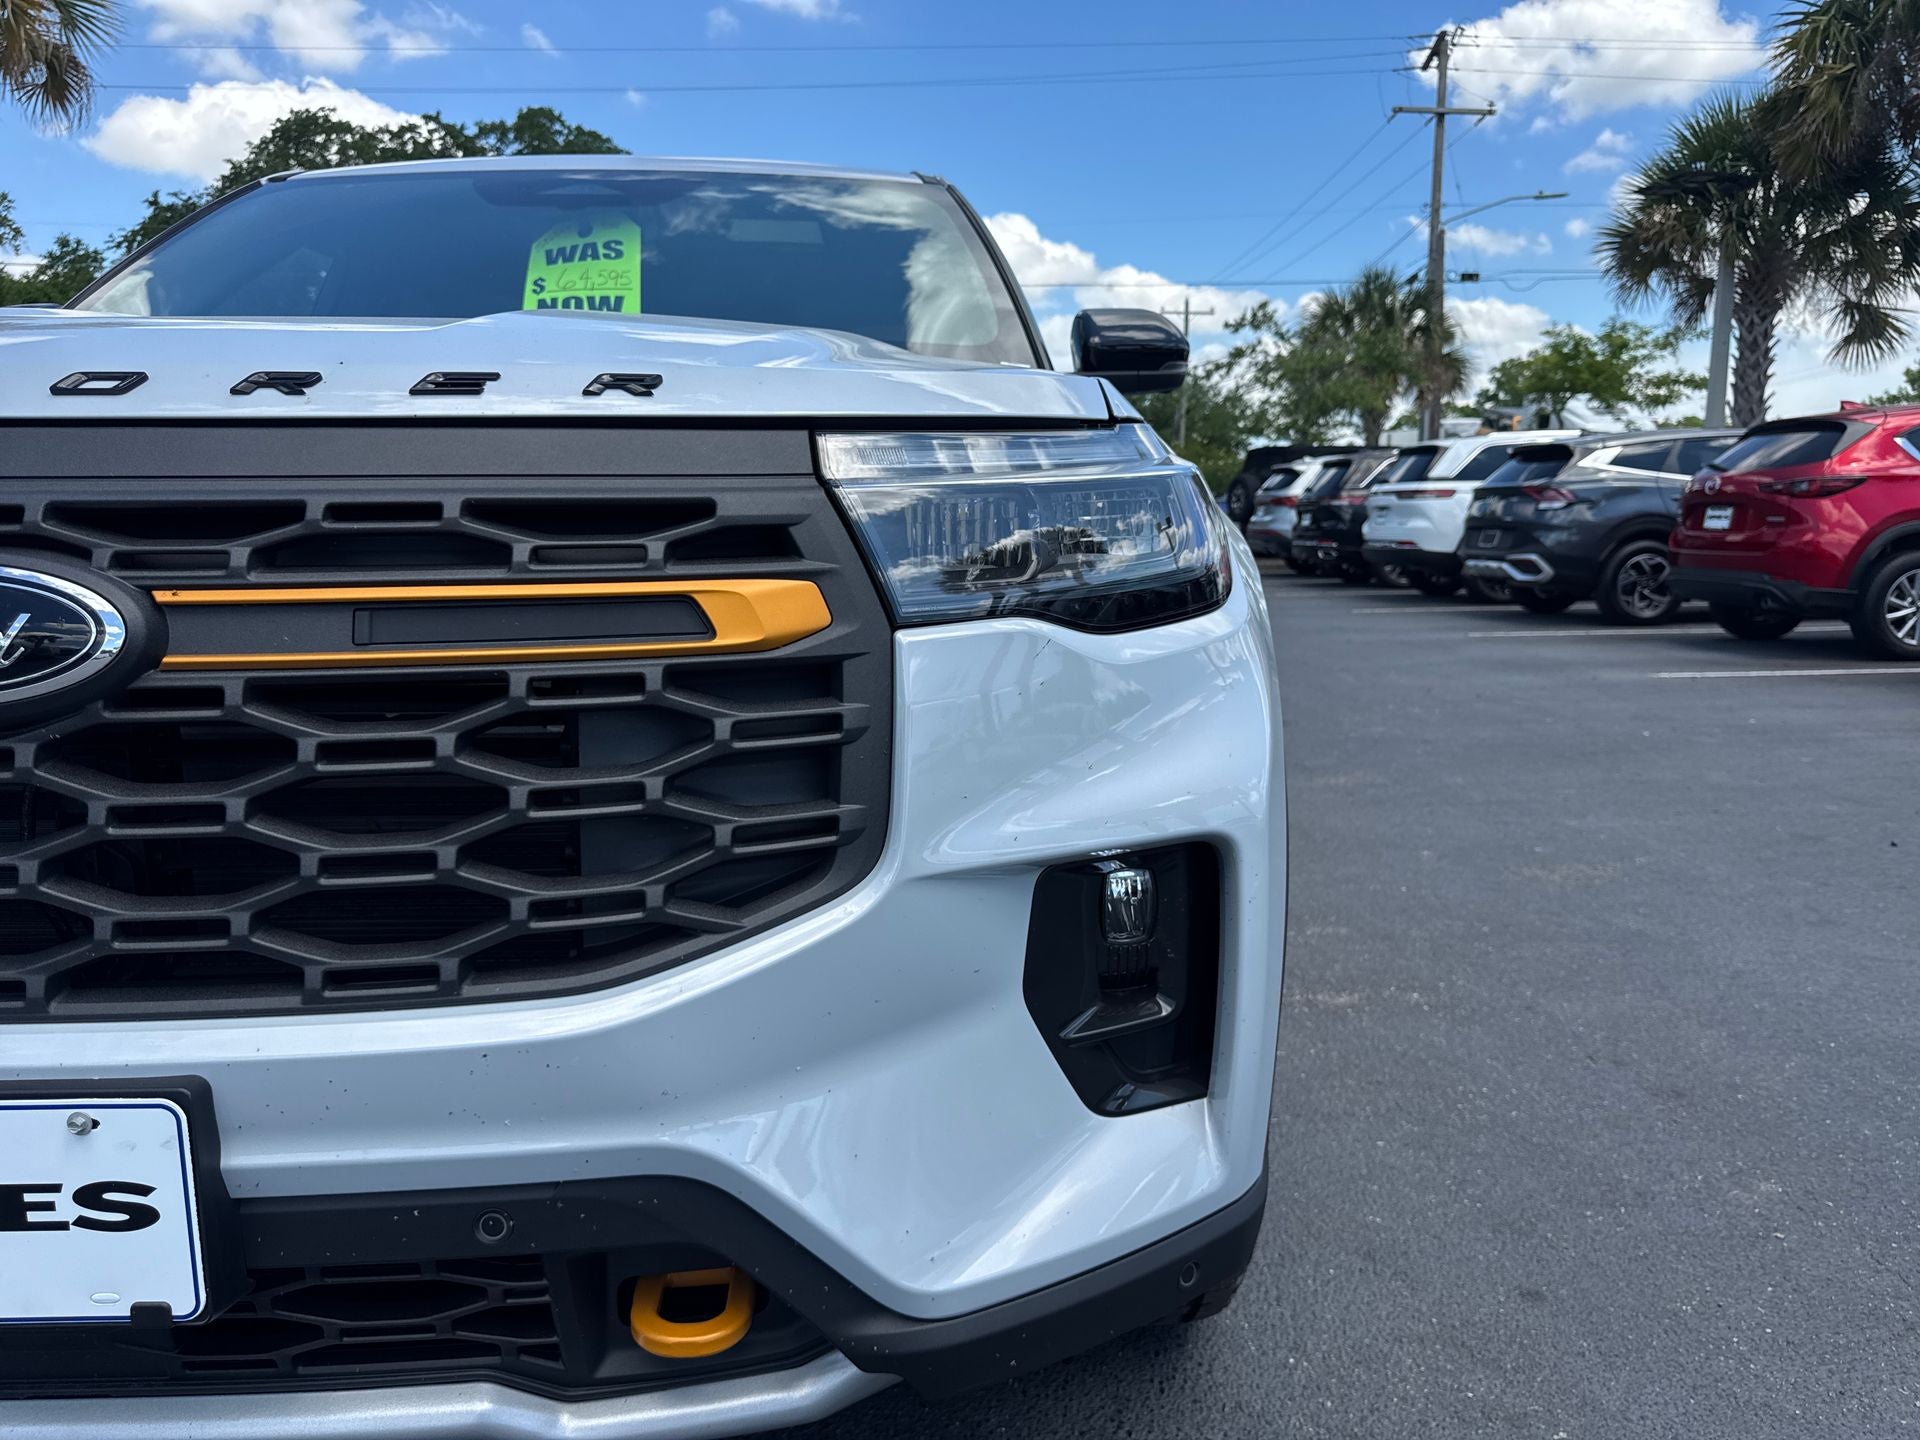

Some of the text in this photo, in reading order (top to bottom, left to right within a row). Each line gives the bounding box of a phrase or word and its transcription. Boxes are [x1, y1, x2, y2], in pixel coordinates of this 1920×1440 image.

[545, 240, 624, 266] WAS
[532, 277, 546, 295] $
[538, 296, 625, 312] NOW
